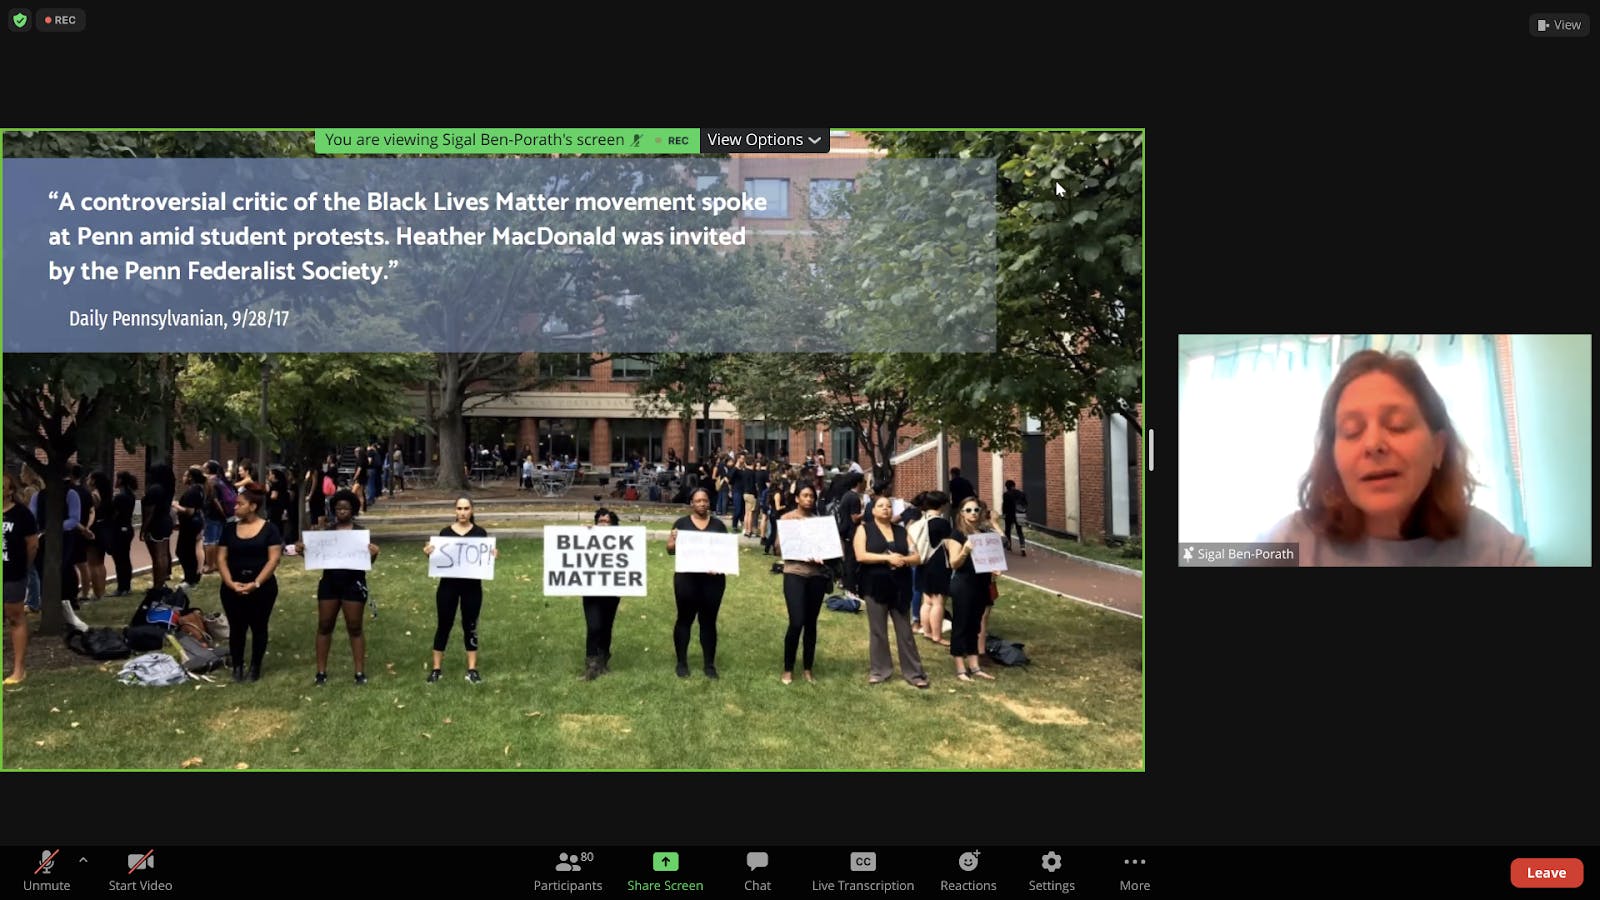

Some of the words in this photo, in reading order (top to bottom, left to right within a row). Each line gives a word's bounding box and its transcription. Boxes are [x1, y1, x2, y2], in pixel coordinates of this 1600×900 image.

[54, 15, 76, 25] REC
[1553, 19, 1582, 31] View
[325, 132, 352, 146] You
[356, 135, 380, 146] are
[383, 132, 439, 150] viewing
[442, 132, 476, 150] Sigal
[480, 132, 573, 146] Ben-Porath's
[576, 135, 625, 146] screen
[668, 136, 689, 146] REC
[707, 132, 742, 146] View
[745, 132, 804, 150] Options
[557, 535, 634, 550] BLACK
[562, 553, 629, 568] LIVES
[1197, 547, 1226, 563] Sigal
[1228, 547, 1294, 561] Ben-Porath
[548, 571, 643, 587] MATTER
[580, 851, 594, 863] 80
[855, 857, 871, 867] CC
[1527, 867, 1567, 879] Leave
[23, 880, 71, 891] Unmute
[108, 880, 137, 891] Start
[139, 879, 173, 891] Video
[534, 880, 603, 894] Participants
[627, 880, 661, 891] Share
[664, 880, 704, 891] Screen
[744, 879, 772, 891] Chat
[812, 880, 835, 891] Live
[837, 880, 915, 895] Transcription
[940, 880, 997, 891] Reactions
[1028, 880, 1076, 894] Settings
[1120, 880, 1151, 891] More
